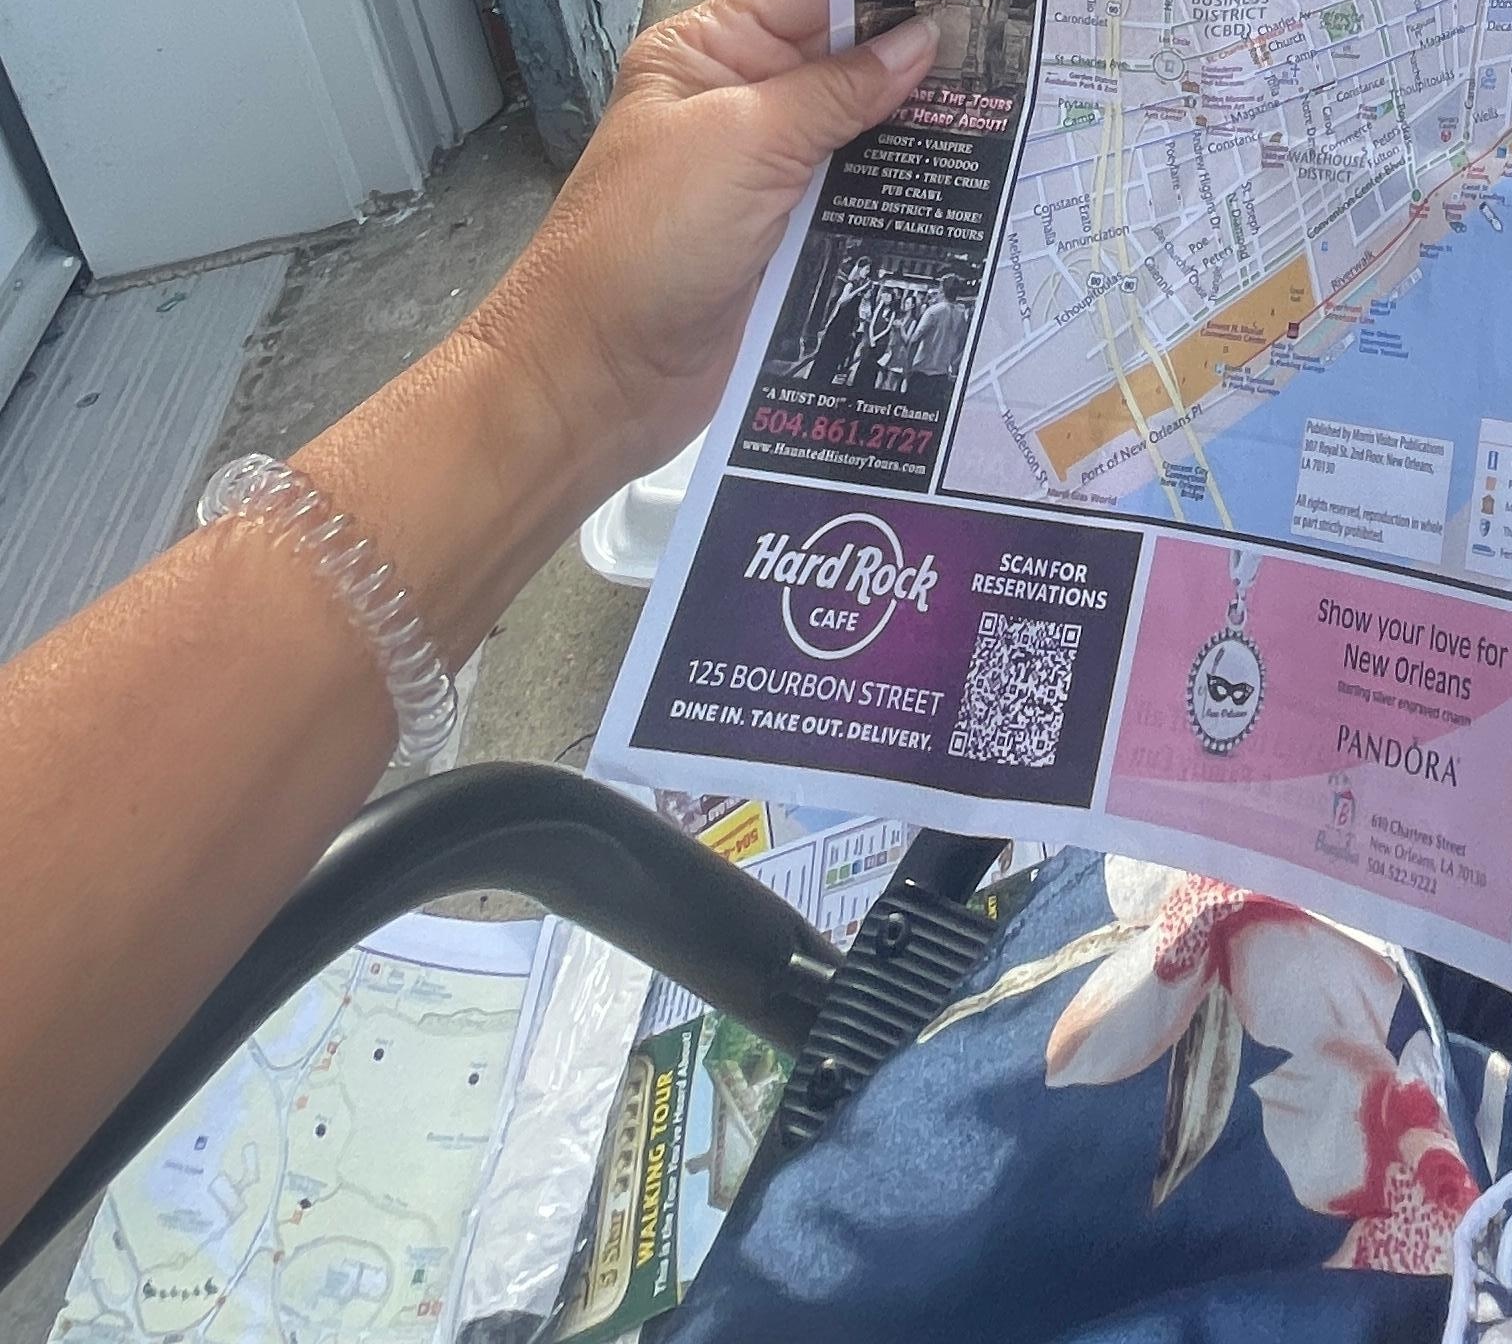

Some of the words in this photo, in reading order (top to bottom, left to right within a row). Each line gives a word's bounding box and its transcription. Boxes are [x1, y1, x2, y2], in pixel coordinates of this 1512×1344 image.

[1192, 7, 1267, 21] DISTRICT
[913, 107, 955, 129] HEARD
[958, 112, 1009, 133] ABOUT!
[742, 438, 927, 476] www.HauntedHistoryTours.com
[751, 406, 933, 456] 504.861.2727
[743, 532, 854, 589] Hard
[848, 543, 940, 613] Rock
[971, 573, 1109, 610] RESERVATIONS
[999, 553, 1049, 578] SCAN
[1050, 559, 1088, 584] FOR
[808, 607, 860, 632] CAFE
[1317, 598, 1373, 633] Show
[1378, 613, 1425, 646] your
[1429, 622, 1471, 659] love
[1476, 633, 1508, 669] for
[687, 658, 727, 688] 125
[729, 665, 864, 706] BOURBON
[857, 679, 945, 717] STREET
[1343, 642, 1390, 678] New
[1395, 656, 1472, 700] Orleans
[669, 699, 719, 723] DINE
[719, 705, 746, 726] IN.
[750, 708, 800, 734] TAKE
[802, 714, 846, 739] OUT.
[846, 720, 933, 752] DELIVERY.
[1337, 724, 1458, 787] PANDORA
[649, 1070, 674, 1140] TOUR
[636, 1141, 667, 1269] WALKING
